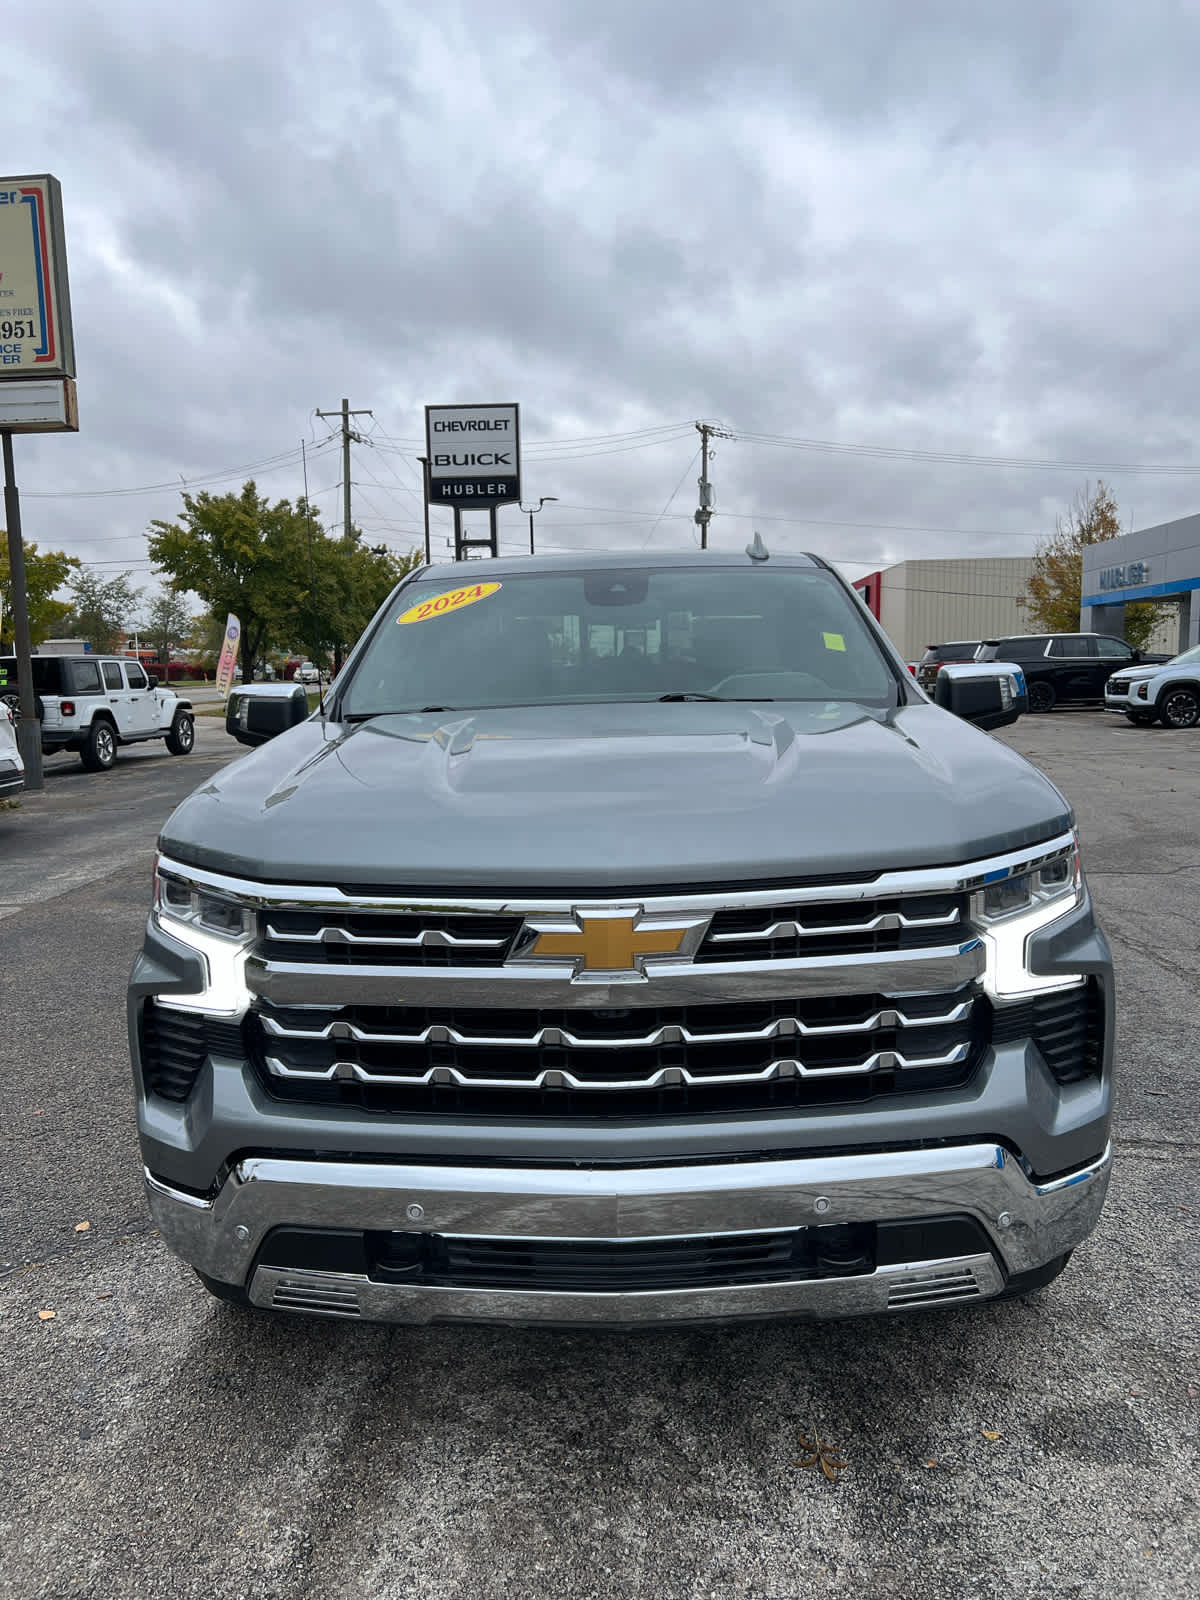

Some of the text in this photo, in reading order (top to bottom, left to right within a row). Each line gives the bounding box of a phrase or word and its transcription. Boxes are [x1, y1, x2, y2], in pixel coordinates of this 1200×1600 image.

[0, 320, 37, 340] 951
[433, 419, 511, 432] CHEVROLET
[433, 452, 512, 466] BUICK
[441, 483, 507, 496] HUBLER
[416, 585, 484, 619] 2024
